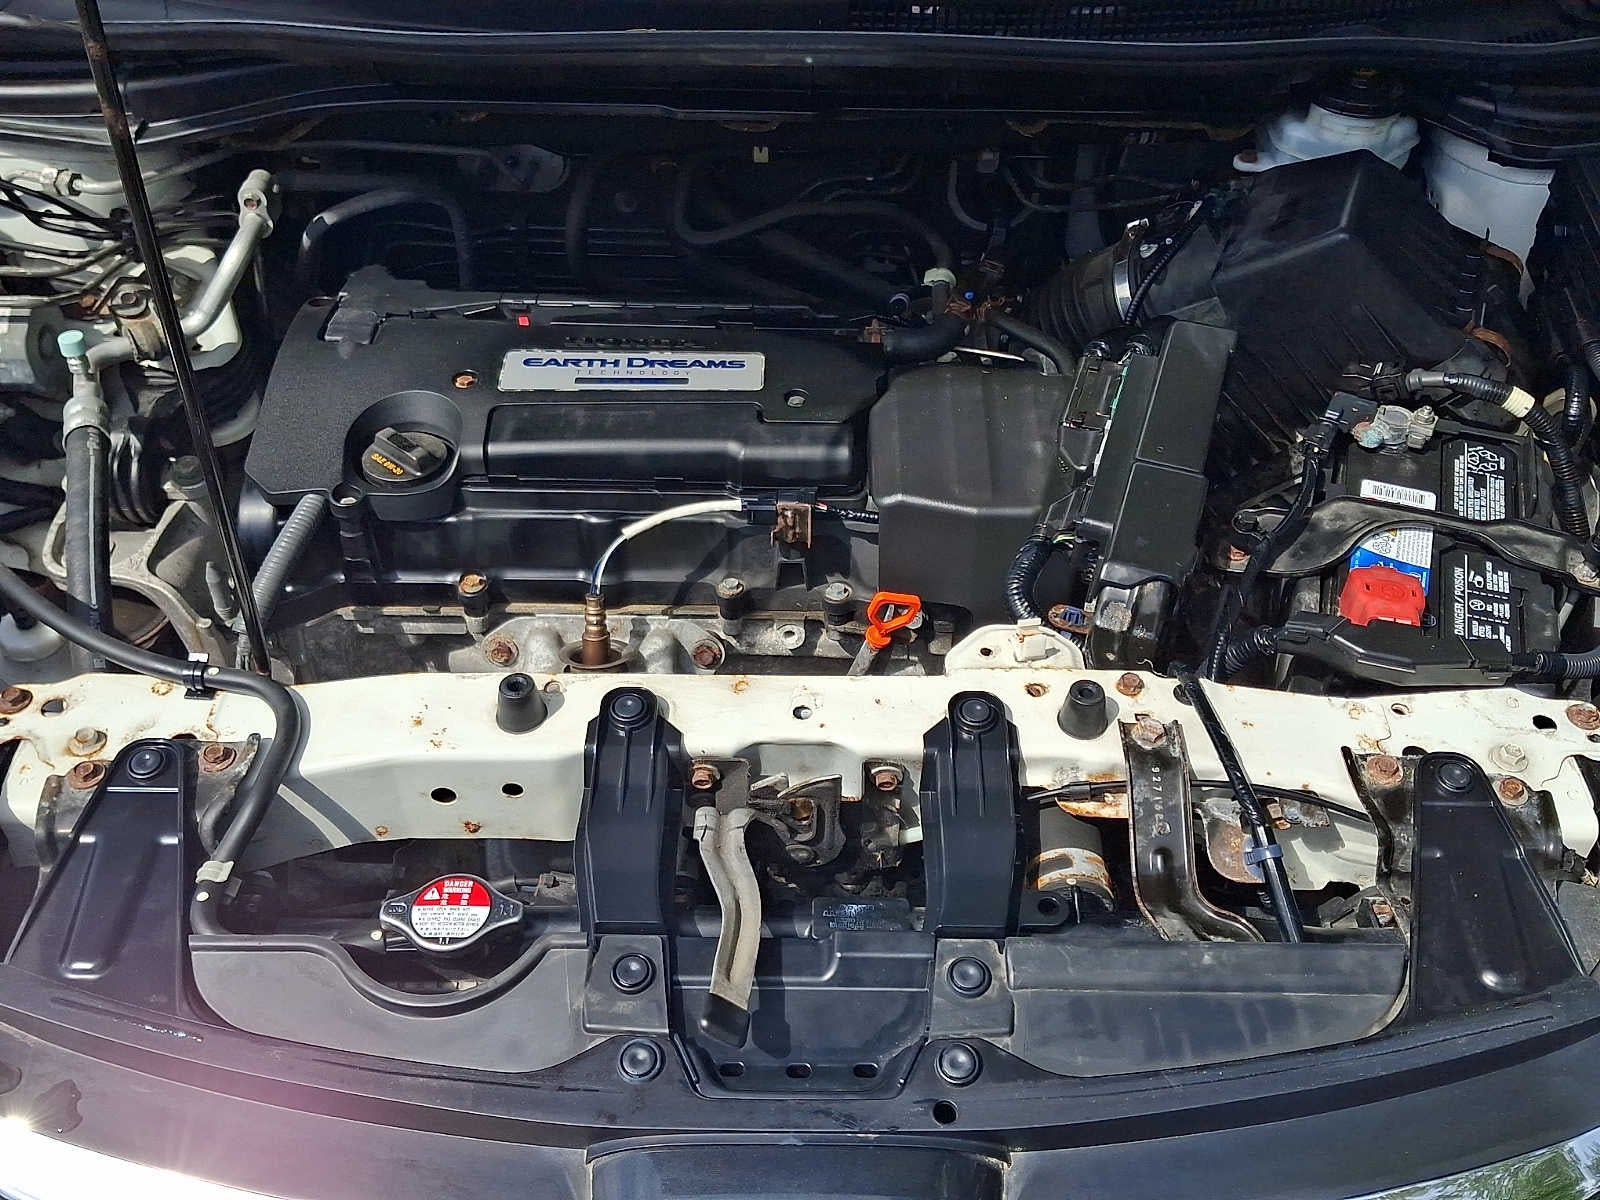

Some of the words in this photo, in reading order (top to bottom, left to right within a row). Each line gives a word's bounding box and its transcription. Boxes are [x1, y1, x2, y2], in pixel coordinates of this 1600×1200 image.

[522, 357, 620, 368] EARTH
[627, 356, 746, 369] DREAMS
[1454, 567, 1464, 596] POISON
[1454, 602, 1464, 636] DANGER
[444, 880, 474, 888] DANGER
